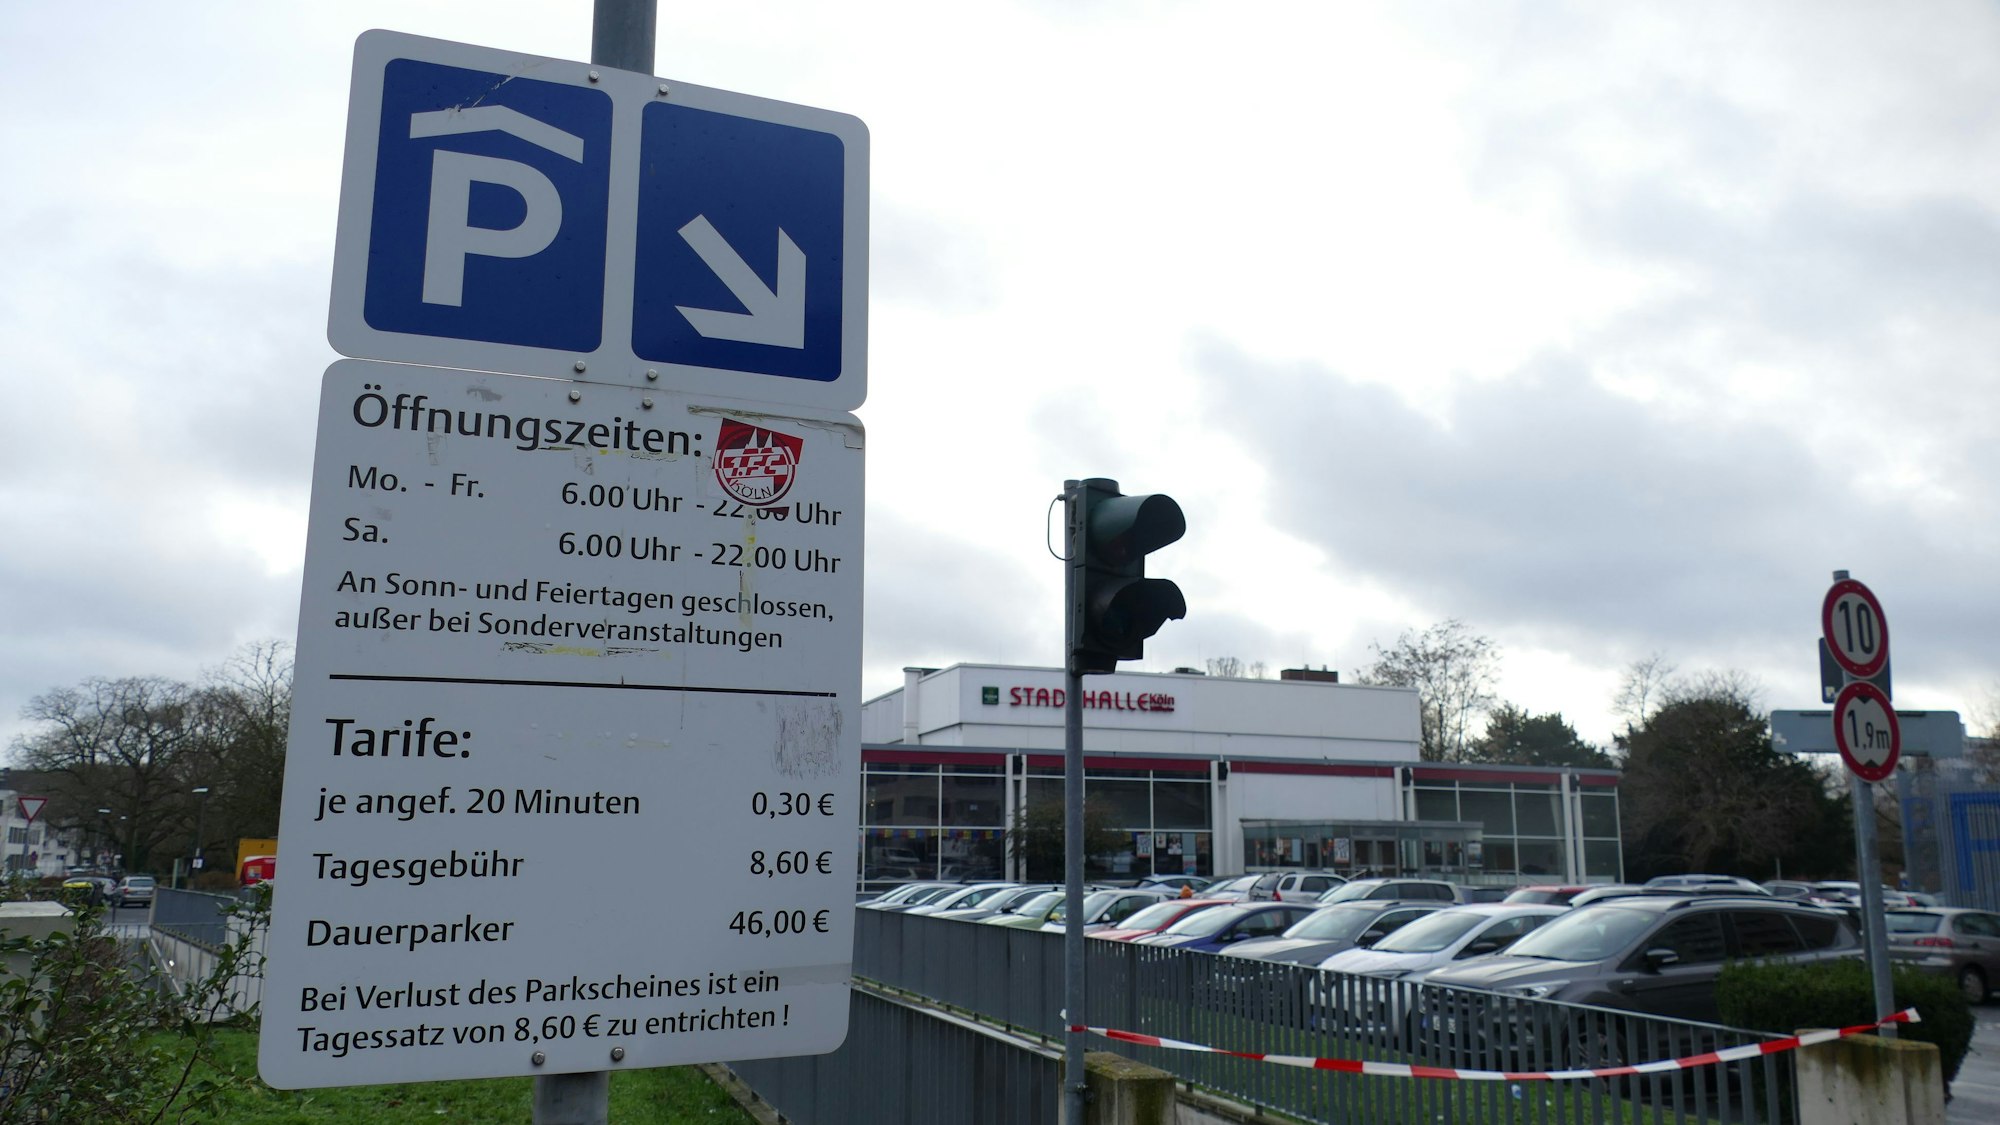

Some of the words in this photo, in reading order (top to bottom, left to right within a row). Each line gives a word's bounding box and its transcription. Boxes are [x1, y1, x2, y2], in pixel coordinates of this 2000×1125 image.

[422, 149, 562, 307] P
[352, 383, 702, 457] Öffnungszeiten:
[348, 464, 407, 493] Mo.
[451, 472, 484, 499] Fr.
[561, 481, 624, 509] 6.00
[633, 487, 683, 513] Uhr
[795, 501, 842, 526] Uhr
[729, 479, 773, 500] KÖLN
[342, 517, 388, 544] Sa.
[558, 531, 622, 559] 6.00
[630, 536, 682, 562] Uhr
[711, 542, 787, 570] 22.00
[794, 548, 841, 574] Uhr
[336, 570, 376, 594] An
[384, 572, 468, 598] Sonn-
[476, 578, 528, 601] und
[536, 581, 674, 614] Feiertagen
[681, 591, 834, 623] geschlossen,
[334, 606, 422, 631] außer
[428, 607, 471, 633] bei
[477, 612, 783, 653] Sonderveranstaltungen
[1838, 600, 1875, 655] 10
[1009, 686, 1149, 712] STADHALLE
[325, 717, 472, 759] Tarife:
[313, 787, 347, 822] je
[355, 786, 456, 822] angef.
[466, 788, 505, 814] 20
[514, 788, 640, 815] Minuten
[751, 791, 811, 820] 0,30
[817, 792, 835, 817] €
[312, 849, 525, 887] Tagesgebühr
[750, 850, 809, 879] 8,60
[815, 850, 833, 875] €
[307, 913, 515, 952] Dauerparker
[728, 909, 806, 939] 46,00
[812, 909, 830, 933] €
[300, 985, 347, 1012] Bei
[355, 981, 461, 1010] Verlust
[468, 978, 517, 1005] des
[525, 973, 701, 1003] Parkscheines
[708, 973, 738, 995] ist
[743, 970, 779, 994] ein
[297, 1023, 445, 1059] Tagessatz
[452, 1024, 505, 1045] von
[514, 1015, 576, 1045] 8,60
[582, 1013, 601, 1038] €
[606, 1018, 637, 1037] zu
[645, 1005, 775, 1035] entrichten
[782, 1004, 789, 1027] !
